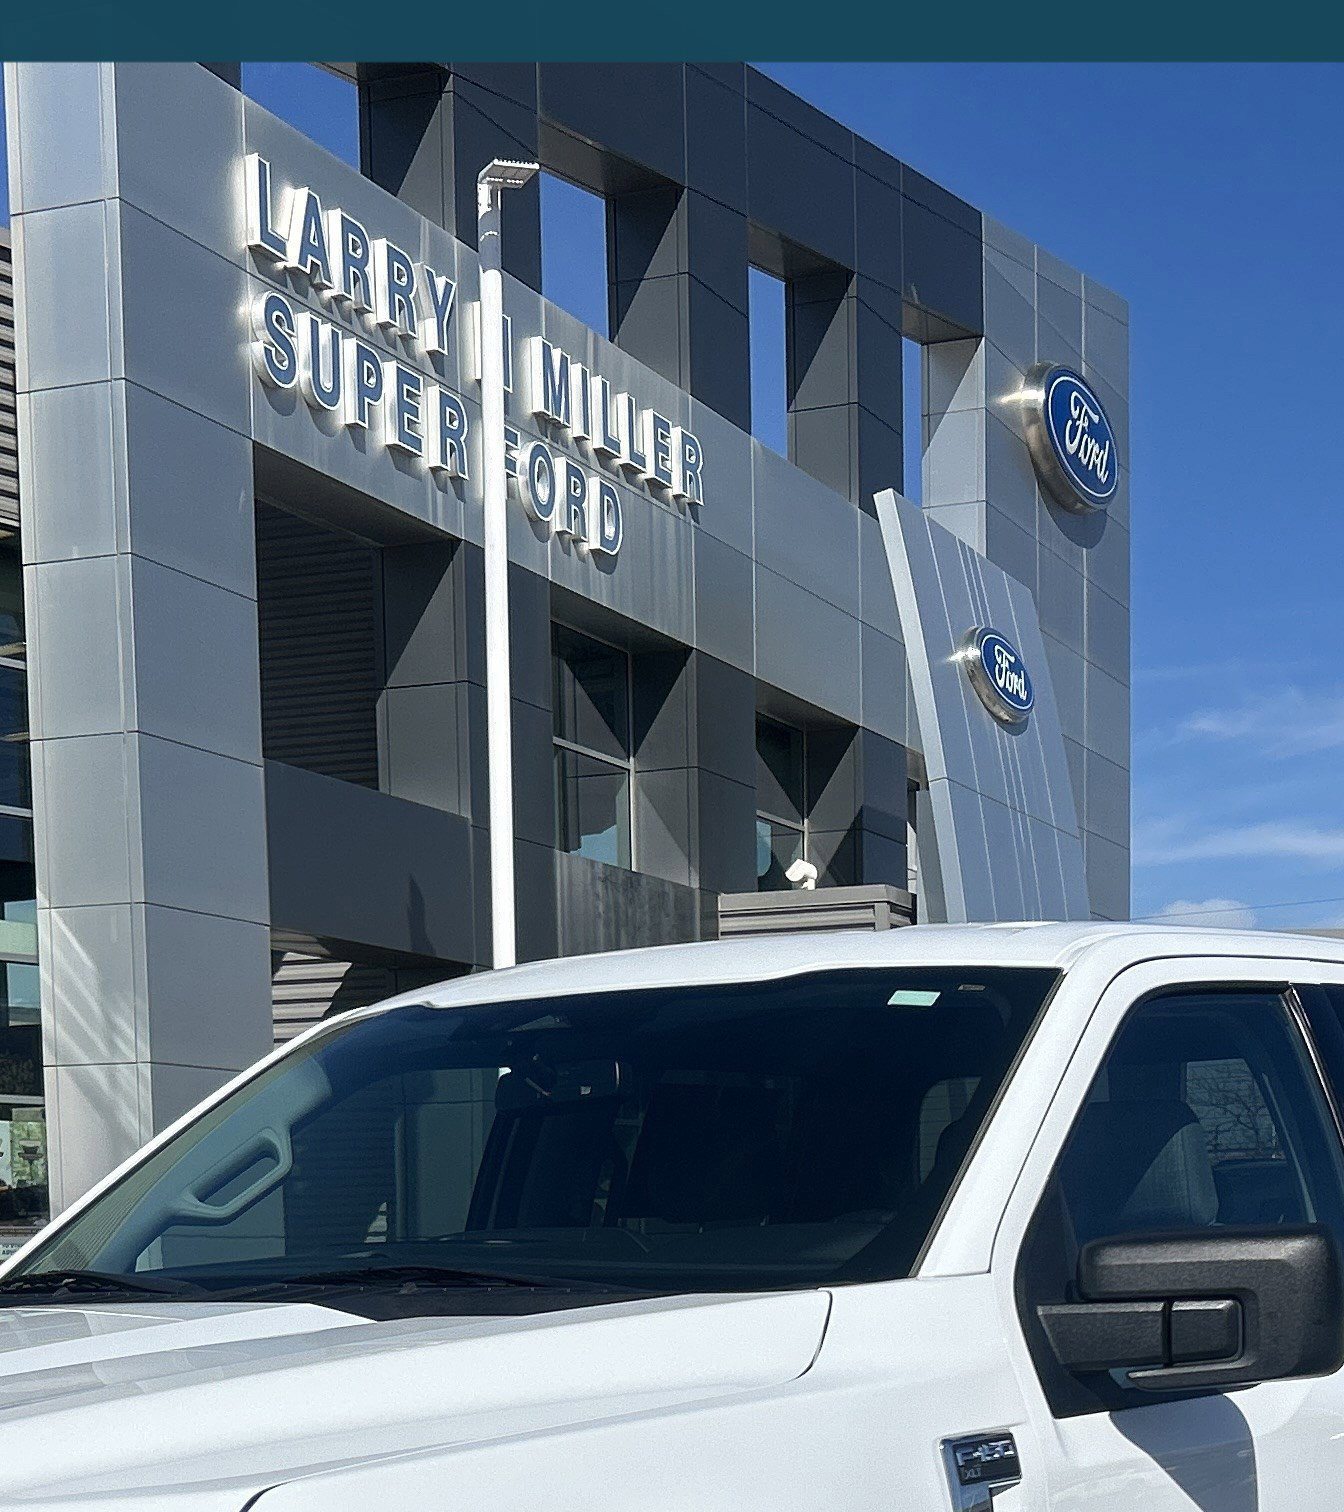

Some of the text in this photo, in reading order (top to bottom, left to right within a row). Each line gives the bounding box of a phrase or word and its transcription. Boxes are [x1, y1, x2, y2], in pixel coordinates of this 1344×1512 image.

[245, 153, 456, 355] LARRY
[531, 336, 705, 506] MILLER
[252, 290, 469, 480] SUPER
[1065, 390, 1110, 484] Ford
[994, 644, 1027, 702] Ford
